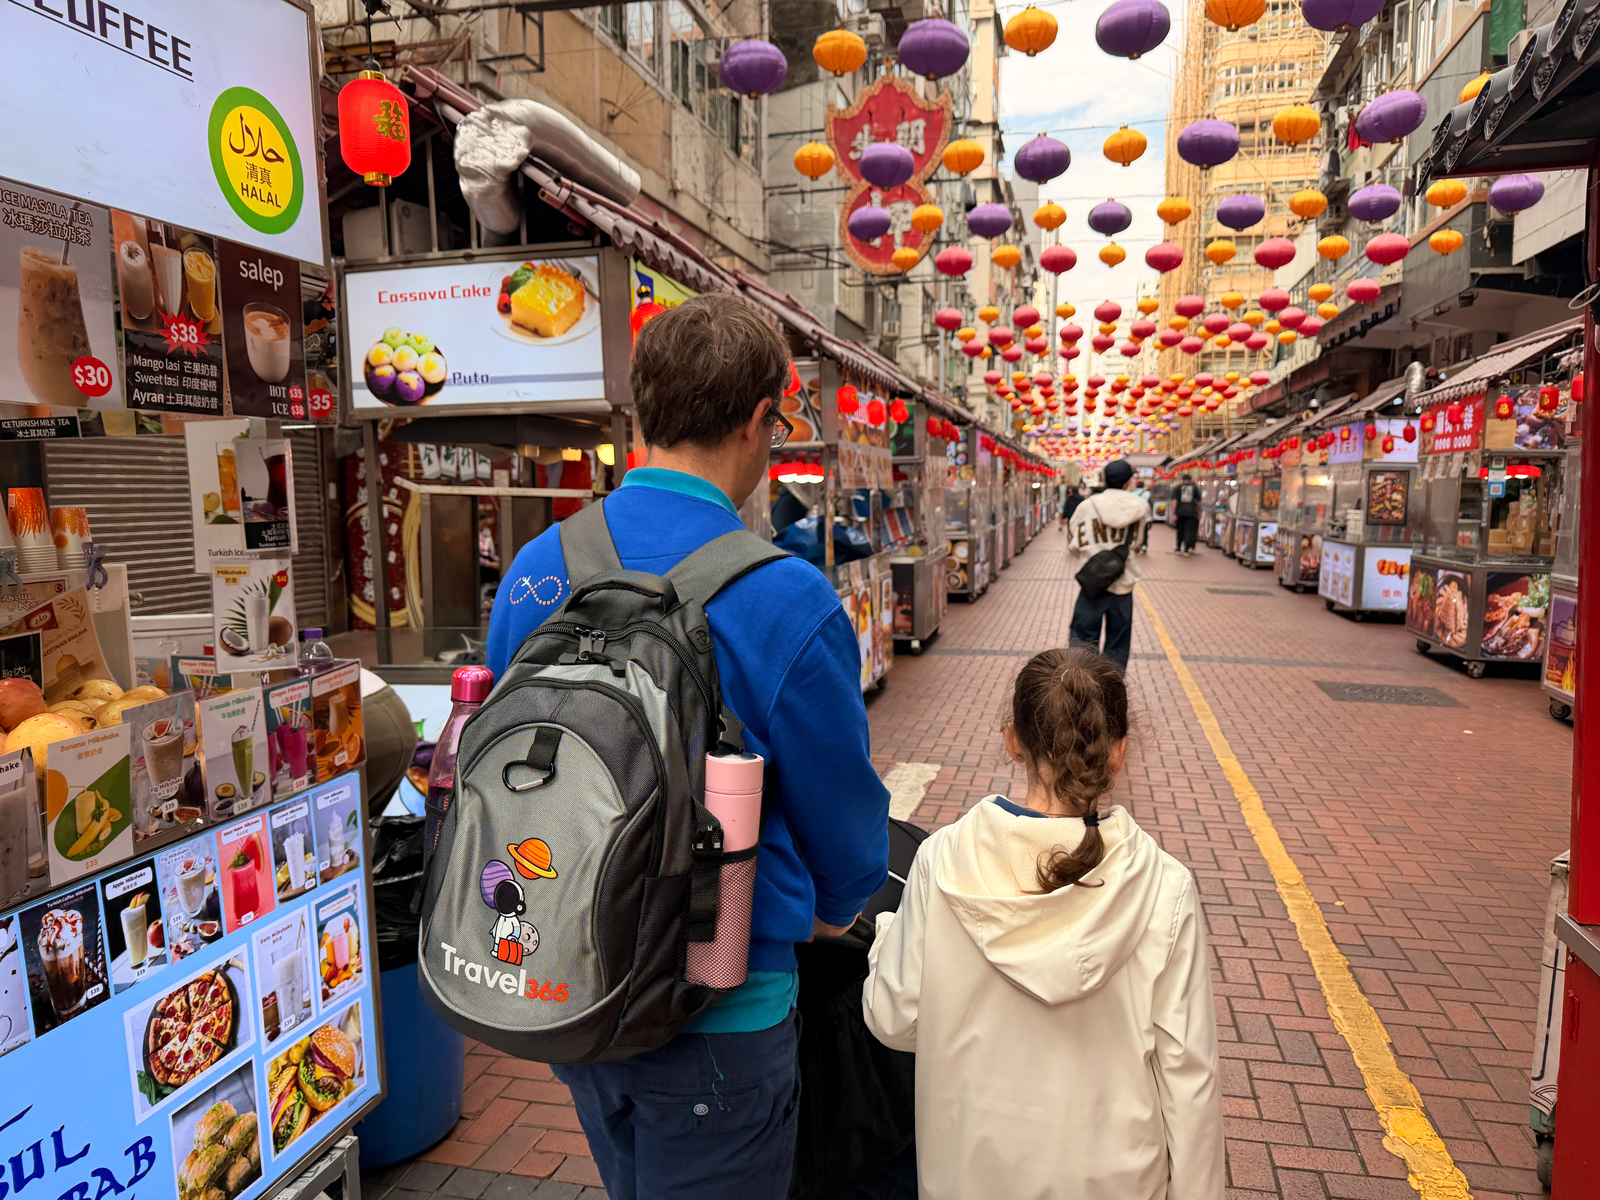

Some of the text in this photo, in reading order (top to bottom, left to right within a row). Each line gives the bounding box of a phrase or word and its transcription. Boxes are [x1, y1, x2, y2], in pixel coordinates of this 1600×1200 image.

[33, 0, 193, 77] OFFEE
[374, 101, 406, 143] 福
[229, 112, 285, 163] حلال
[245, 161, 272, 188] 清真
[240, 182, 282, 208] HALAL
[20, 193, 68, 220] MASALA
[70, 208, 93, 227] TEA
[2, 207, 92, 246] 冰瑪莎拉奶茶
[239, 259, 284, 291] salep
[378, 284, 492, 305] Cassava Cake
[170, 323, 199, 344] $38
[74, 364, 109, 388] $30
[133, 354, 218, 377] Mango lasi 芒果奶昔
[134, 371, 162, 385] Sweet
[164, 374, 179, 387] lasi
[452, 371, 490, 385] Puto
[132, 388, 165, 404] Ayran
[269, 384, 302, 399] HOT $35
[272, 402, 289, 415] ICE
[1, 418, 70, 429] ICE TURKISH MILK TEA
[207, 548, 233, 557] Turkish
[270, 690, 287, 700] Dragon
[60, 732, 119, 752] Banana Milkshake
[165, 802, 175, 811] $39
[85, 859, 98, 870] $39
[441, 941, 569, 1003] Travel365
[0, 1124, 91, 1200] UL
